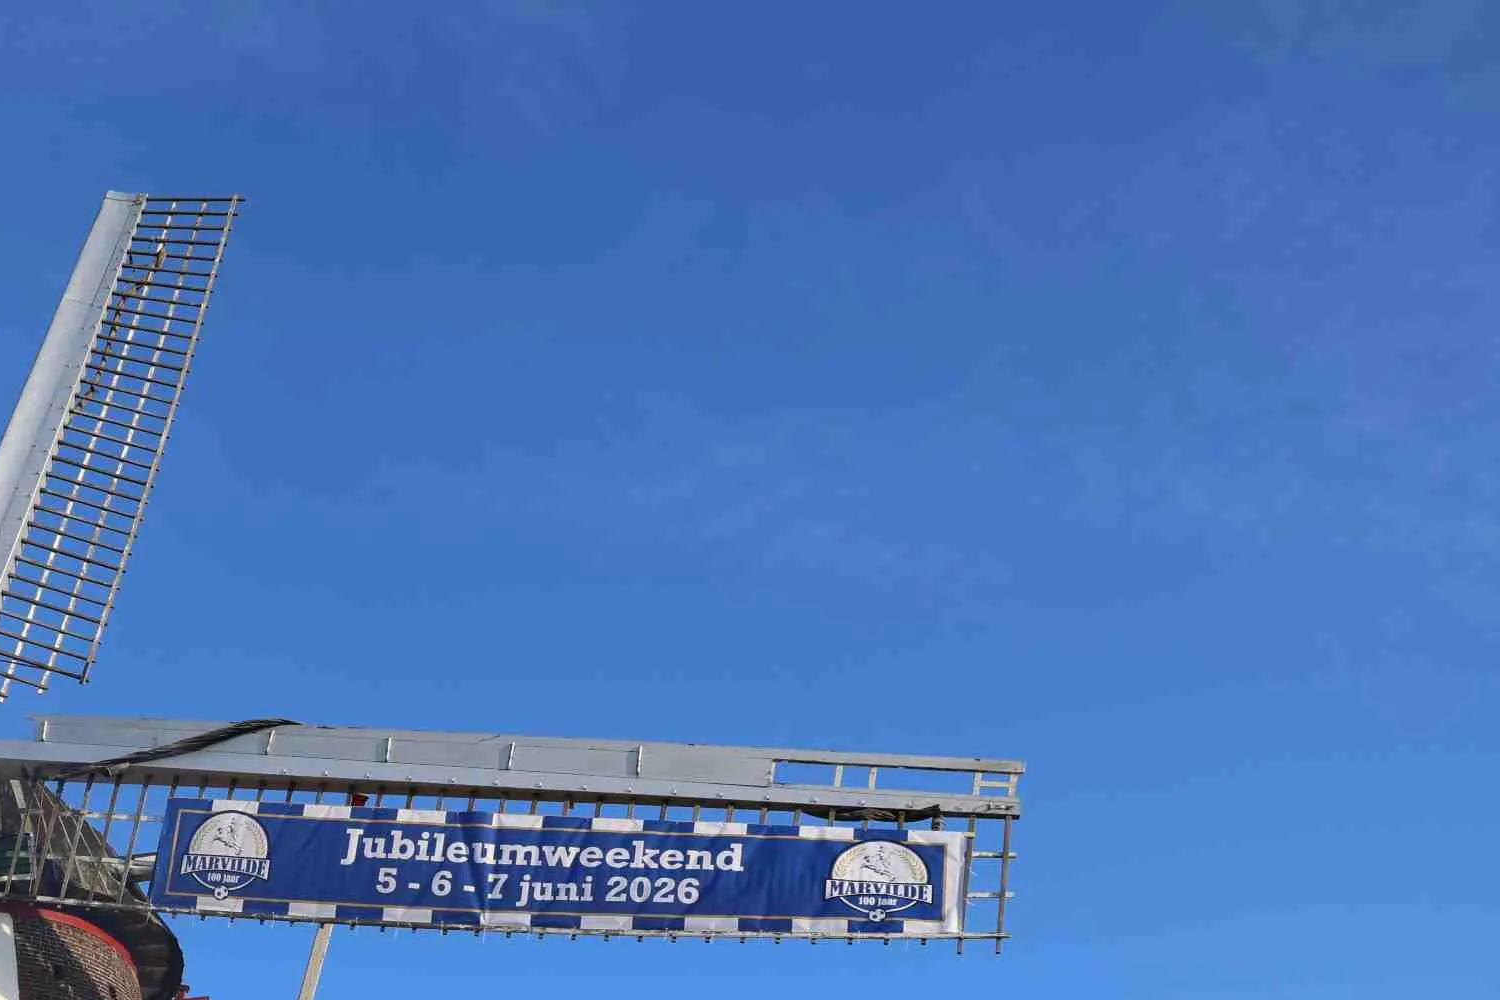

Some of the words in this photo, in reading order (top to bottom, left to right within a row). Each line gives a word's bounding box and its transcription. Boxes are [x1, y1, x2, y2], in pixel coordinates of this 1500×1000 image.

[340, 828, 744, 873] Jubileumweekend
[376, 867, 397, 894] 5
[431, 870, 453, 896] 6
[487, 873, 508, 900] 7
[515, 874, 594, 907] juni
[605, 876, 700, 904] 2026
